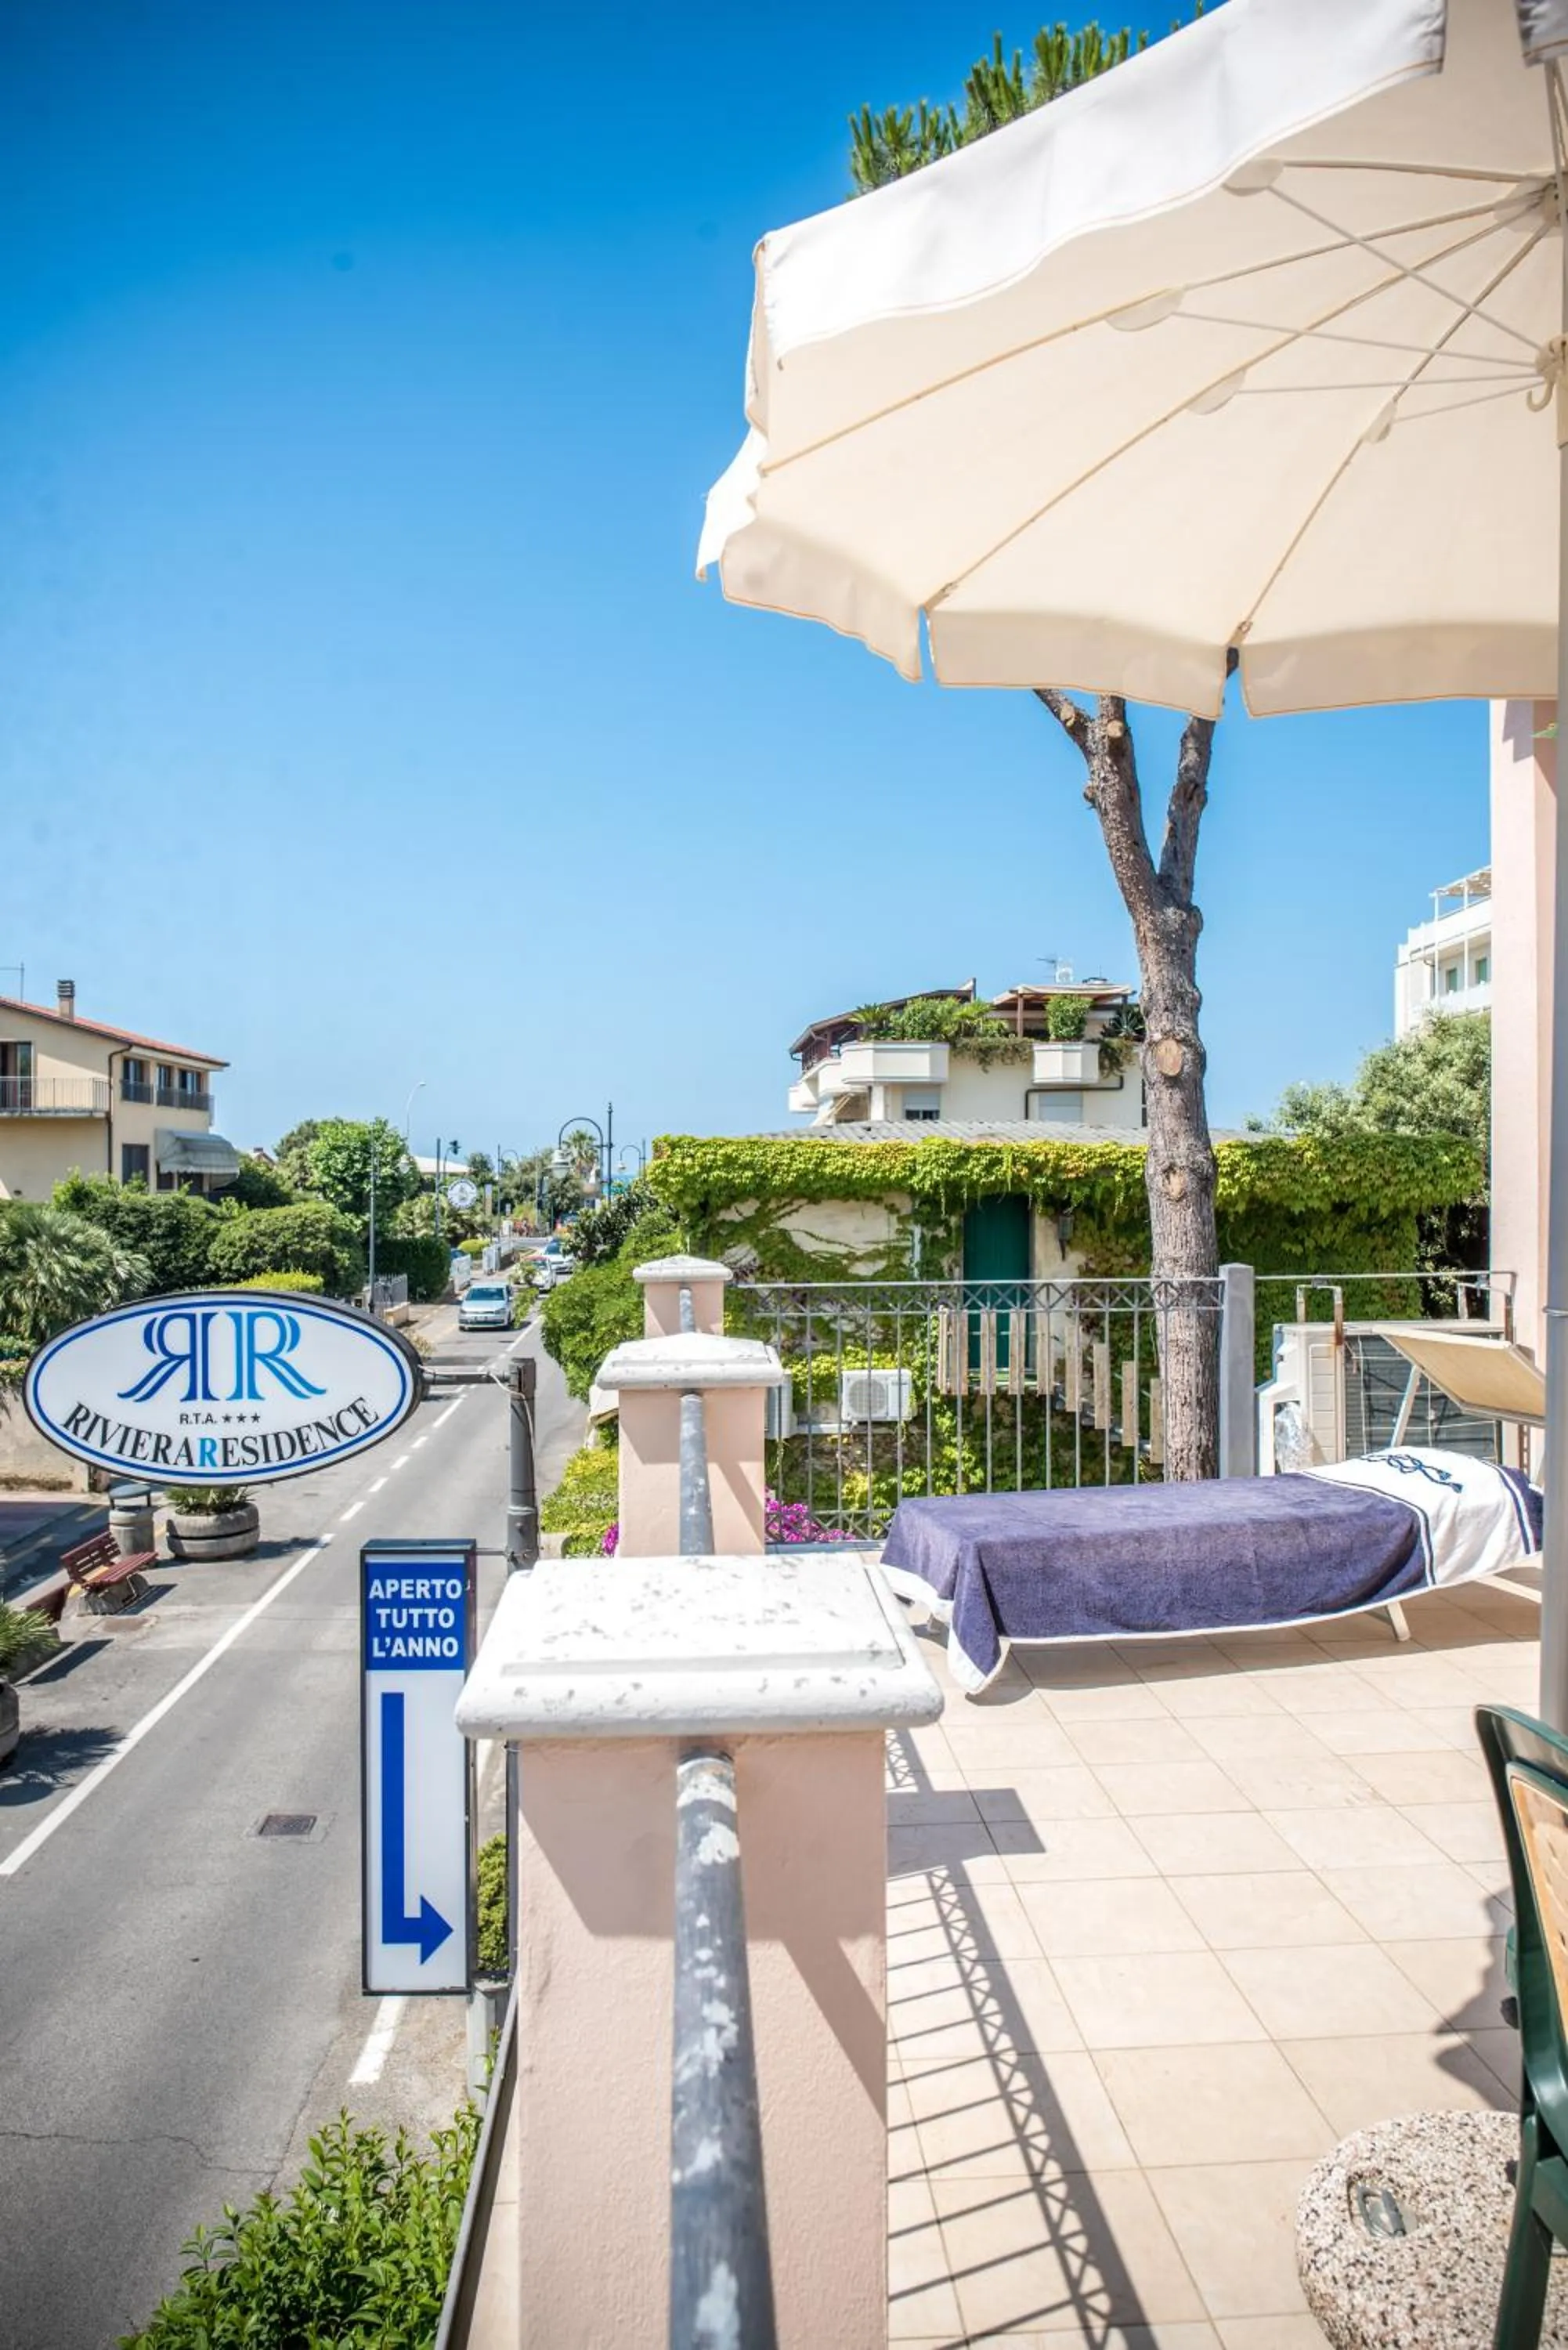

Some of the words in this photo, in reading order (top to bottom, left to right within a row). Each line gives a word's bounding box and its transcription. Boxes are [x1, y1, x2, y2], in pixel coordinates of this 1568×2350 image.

[179, 1412, 218, 1425] R.T.A.
[369, 1578, 463, 1599] APERTO
[375, 1607, 455, 1629] TUTTO
[372, 1636, 459, 1658] L'ANNO
